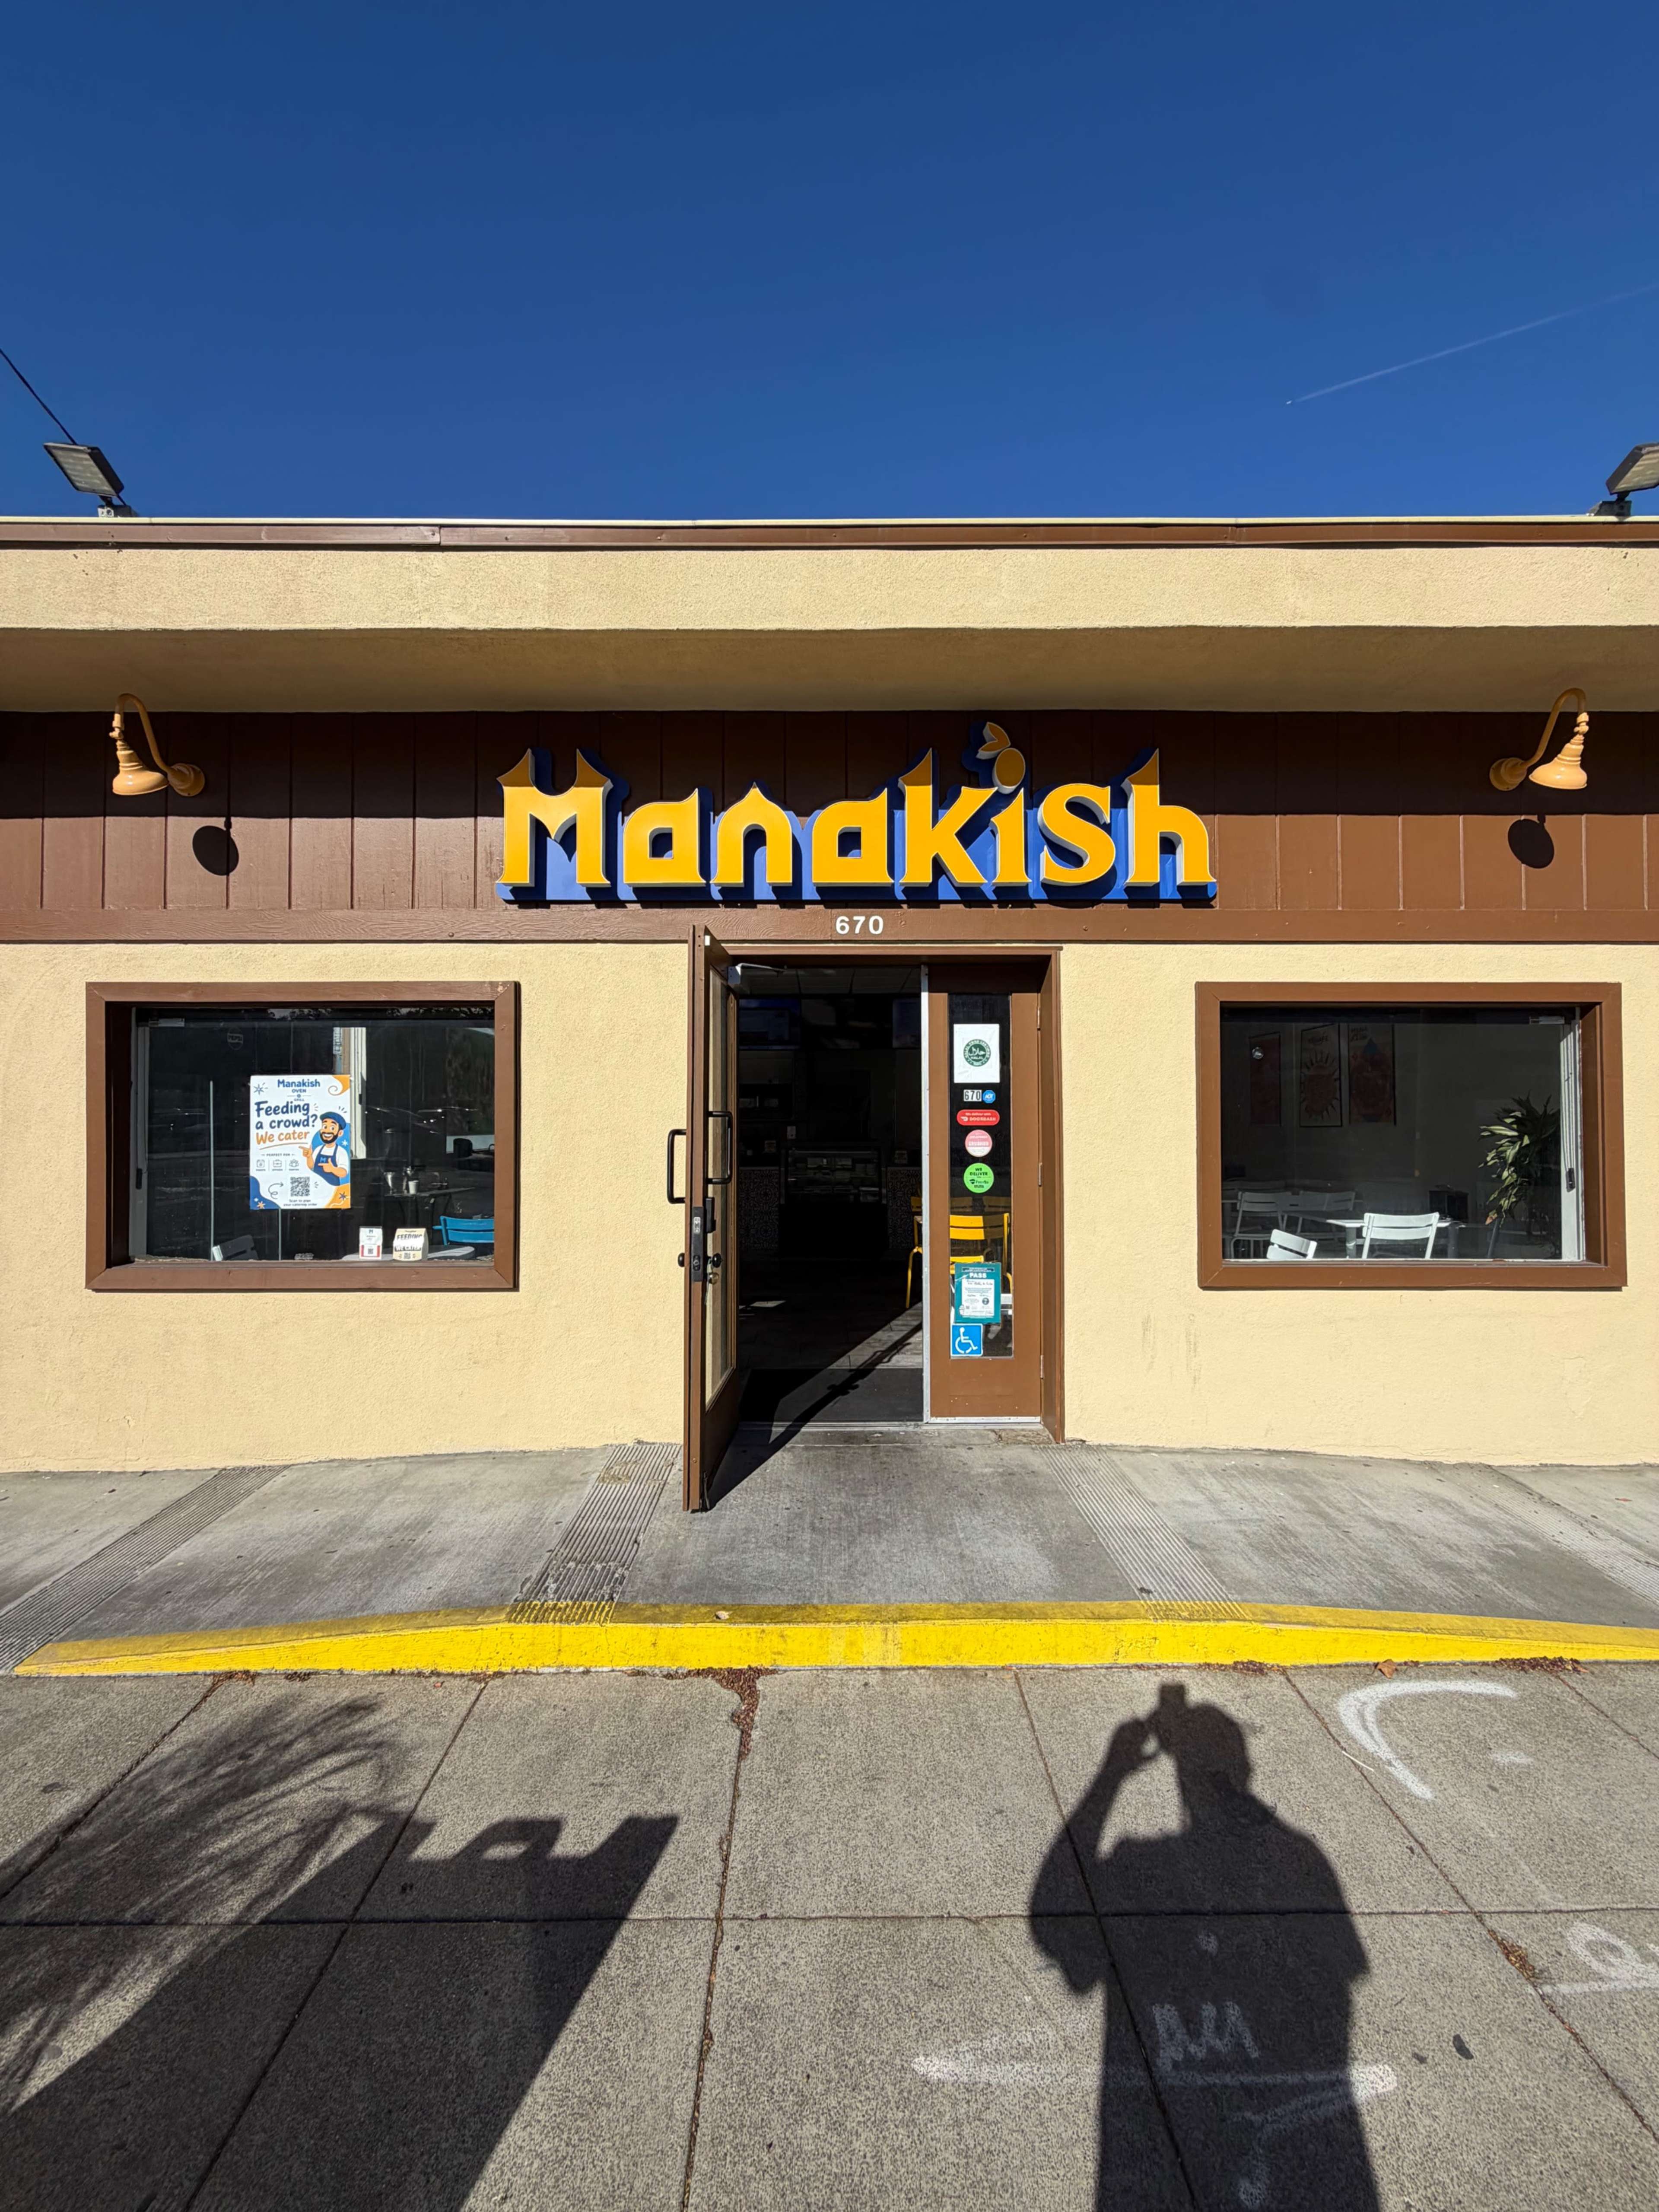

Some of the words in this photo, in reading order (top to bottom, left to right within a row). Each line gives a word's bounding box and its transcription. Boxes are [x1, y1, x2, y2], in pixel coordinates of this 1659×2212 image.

[497, 722, 1216, 887] Manakish
[836, 915, 884, 935] 670
[277, 1079, 321, 1088] Manakish
[965, 1091, 981, 1101] 670
[254, 1101, 310, 1118] Feeding
[255, 1120, 264, 1130] a
[269, 1113, 318, 1129] crowd?
[256, 1131, 275, 1145] We
[278, 1129, 310, 1142] cater
